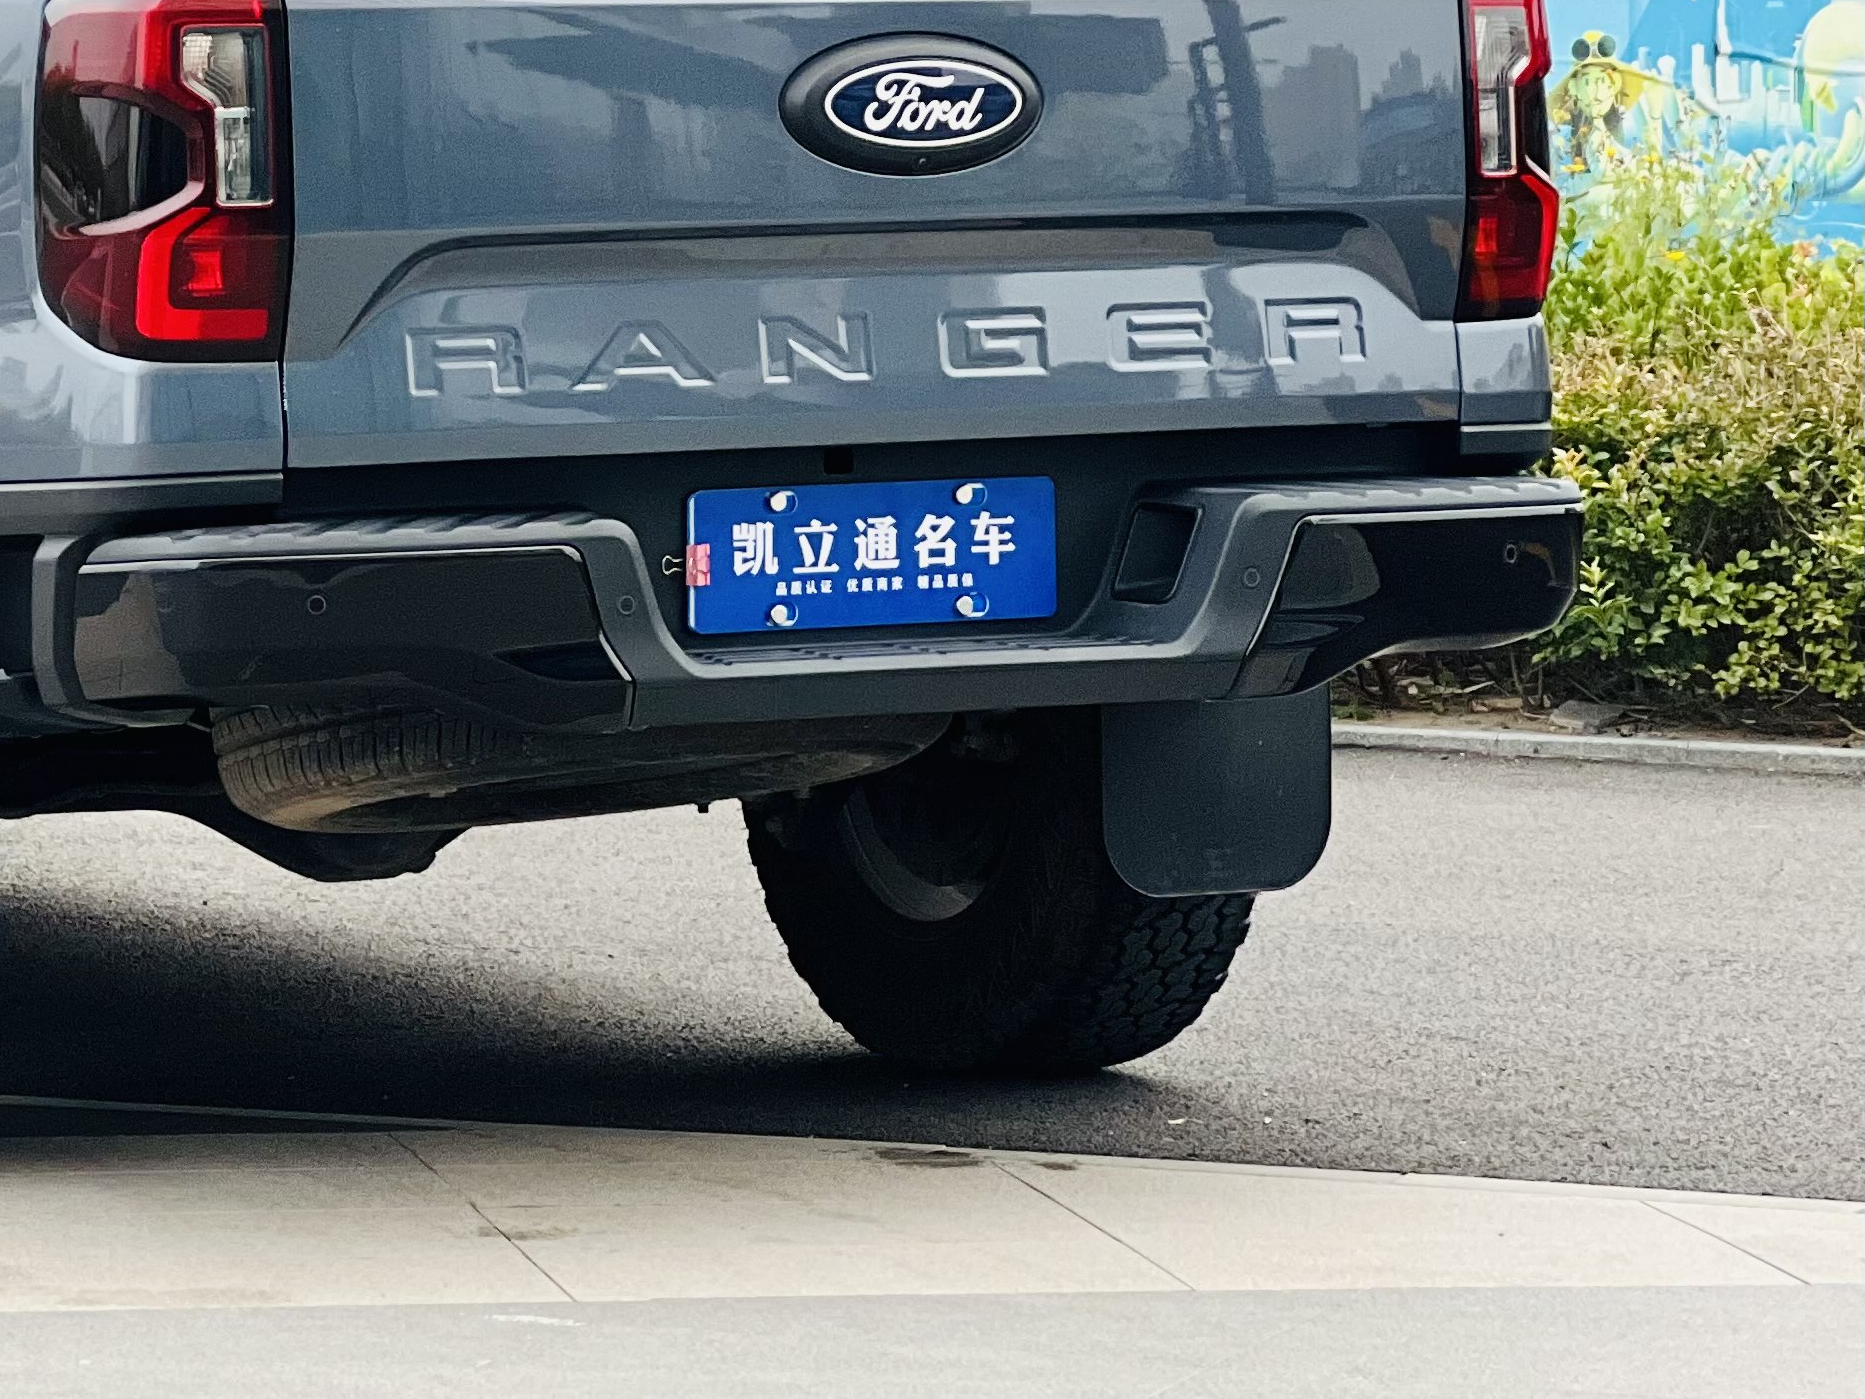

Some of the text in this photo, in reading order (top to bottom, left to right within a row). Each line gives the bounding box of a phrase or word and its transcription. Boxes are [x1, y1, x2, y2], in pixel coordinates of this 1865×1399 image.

[863, 71, 985, 132] Ford
[405, 297, 1367, 397] RANGER
[732, 510, 1017, 577] 凯立通名车
